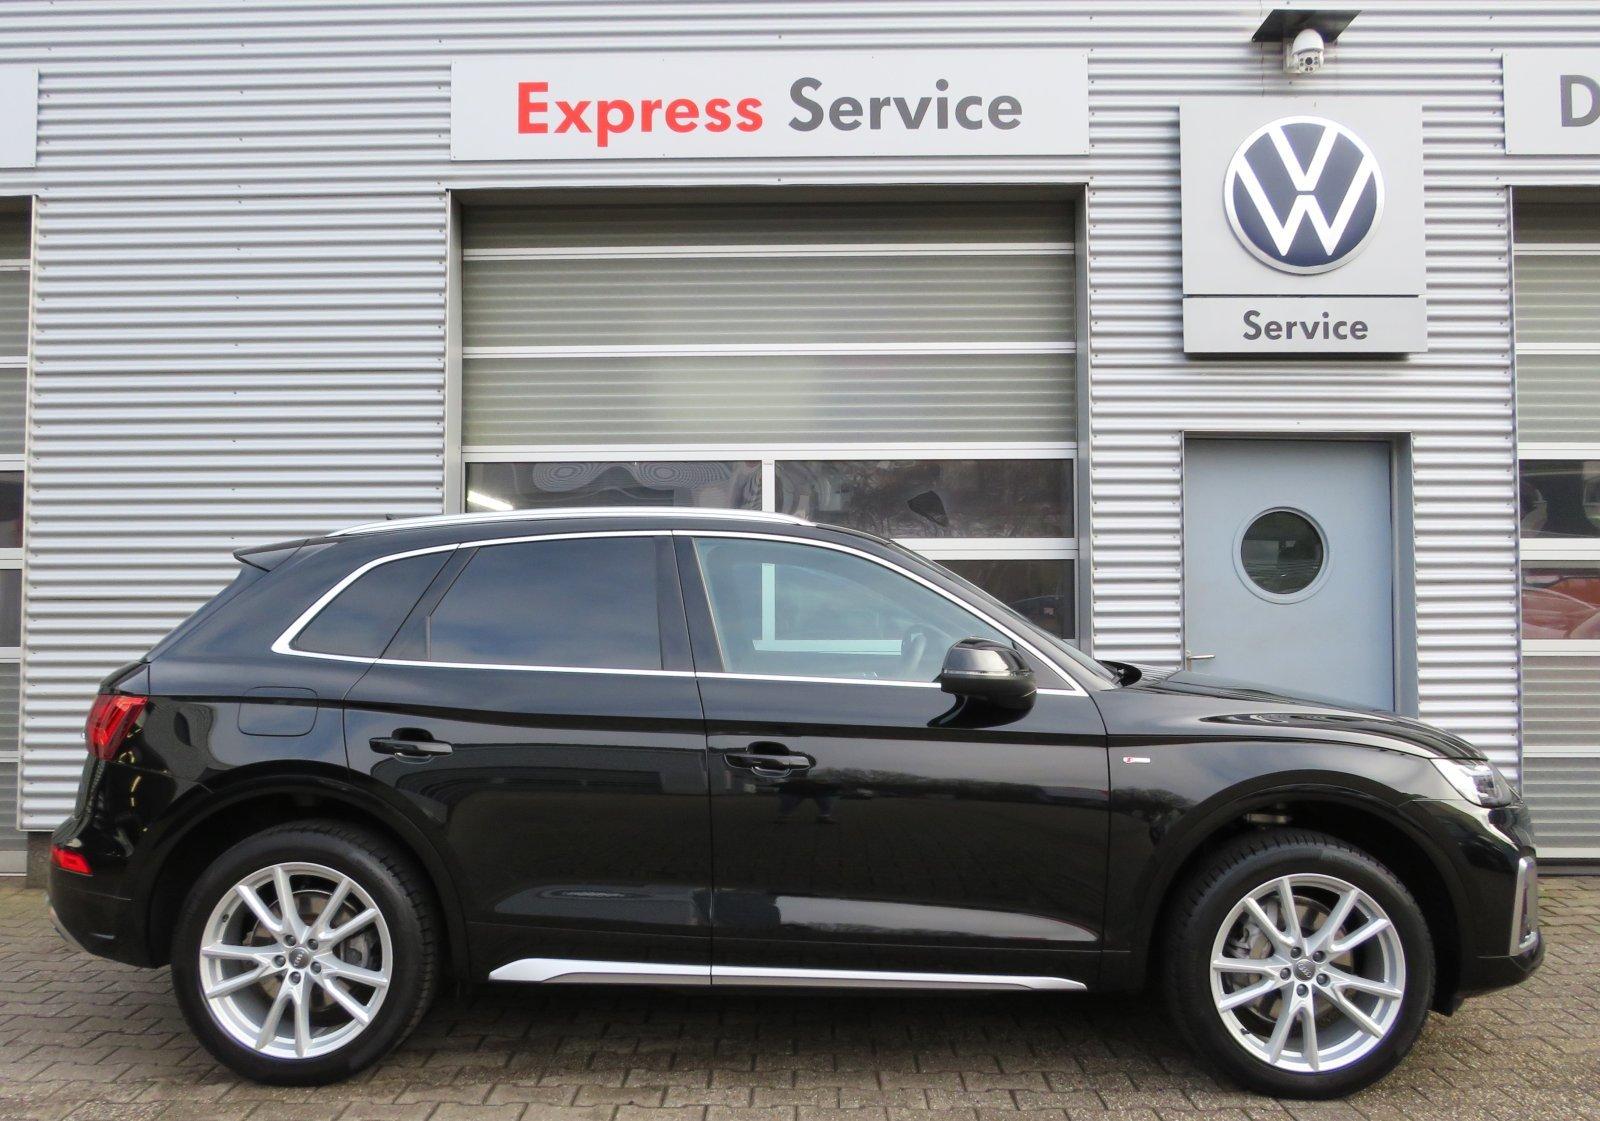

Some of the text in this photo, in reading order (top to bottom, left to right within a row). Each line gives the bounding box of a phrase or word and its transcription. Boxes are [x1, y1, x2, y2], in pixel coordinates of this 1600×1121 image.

[518, 77, 1023, 147] Express Service
[1230, 121, 1378, 258] VW
[1242, 309, 1369, 341] Service
